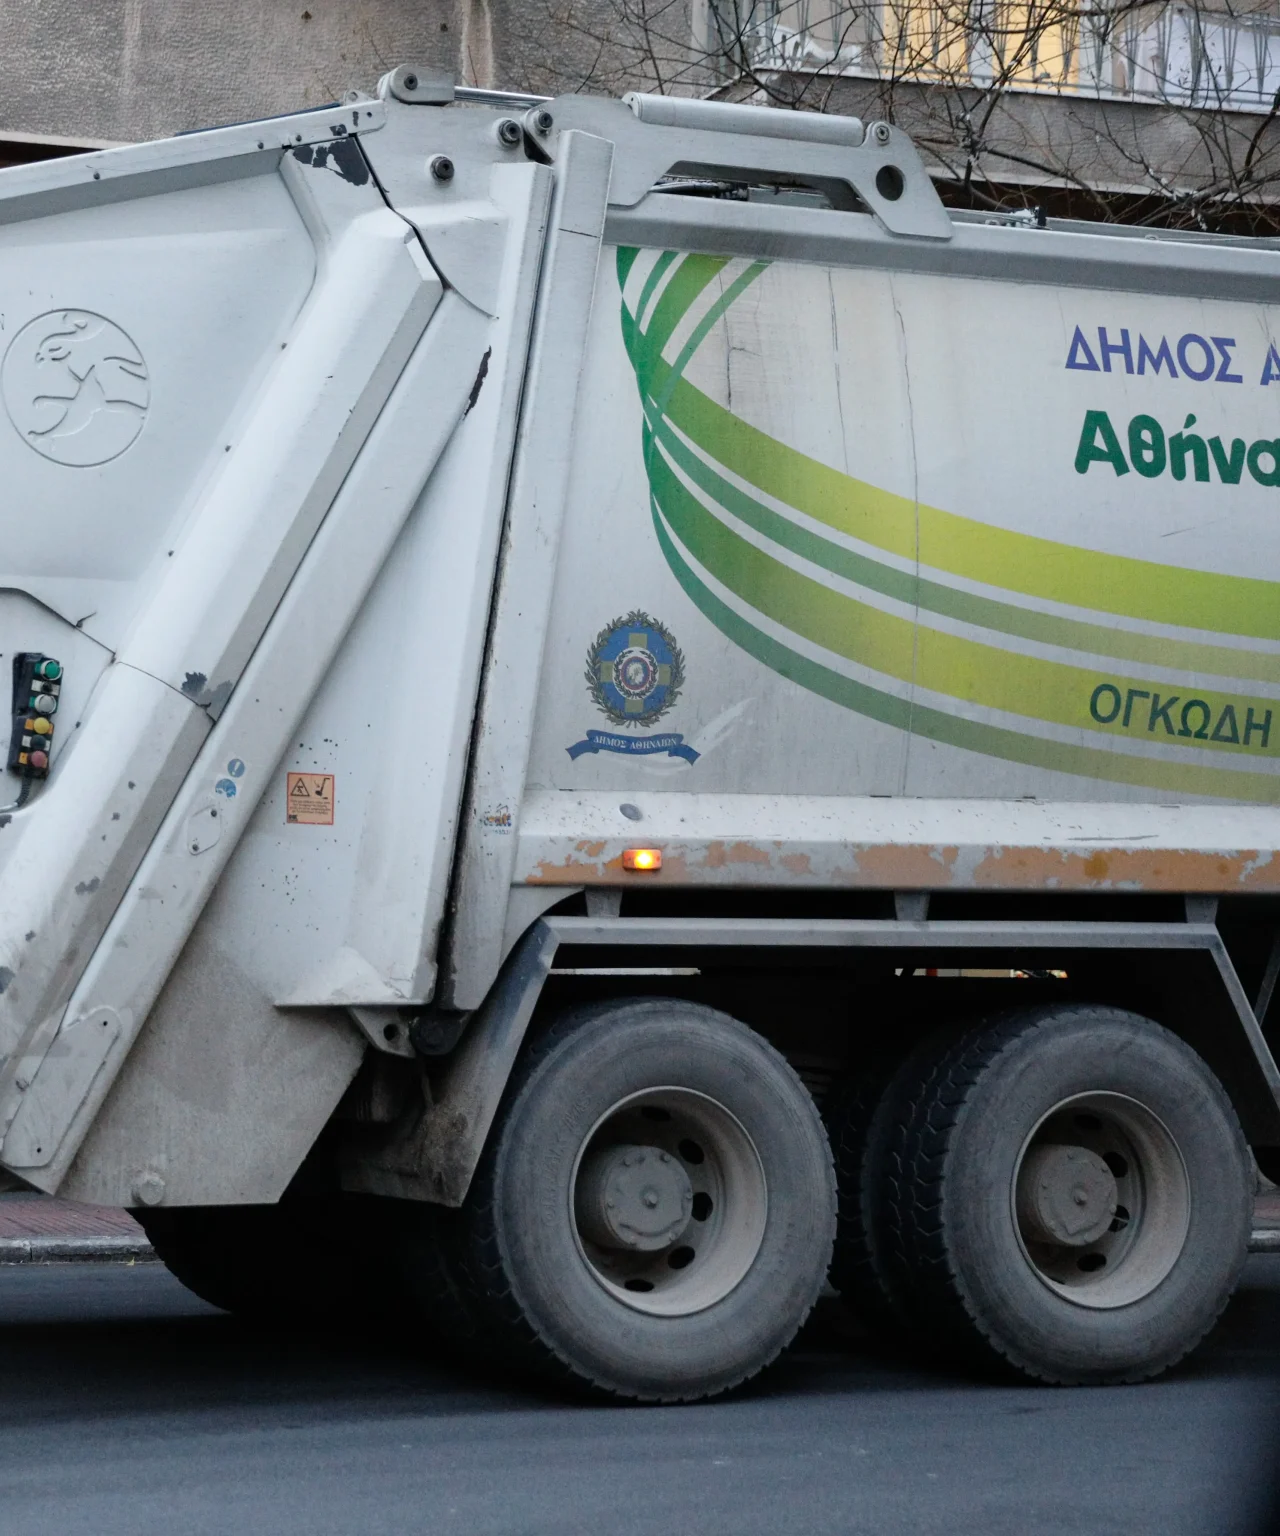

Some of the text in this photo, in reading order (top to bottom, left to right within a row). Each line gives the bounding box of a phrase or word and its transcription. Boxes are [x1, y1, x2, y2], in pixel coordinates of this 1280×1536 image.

[1065, 324, 1243, 384] ΔΗΜΟΣ
[1074, 409, 1280, 488] Αθήνα
[593, 735, 677, 750] ΔΗΜΟΣ ΑΘΗΝΑΙΩΝ
[1089, 683, 1273, 748] ΟΓΚΩΔΗ
